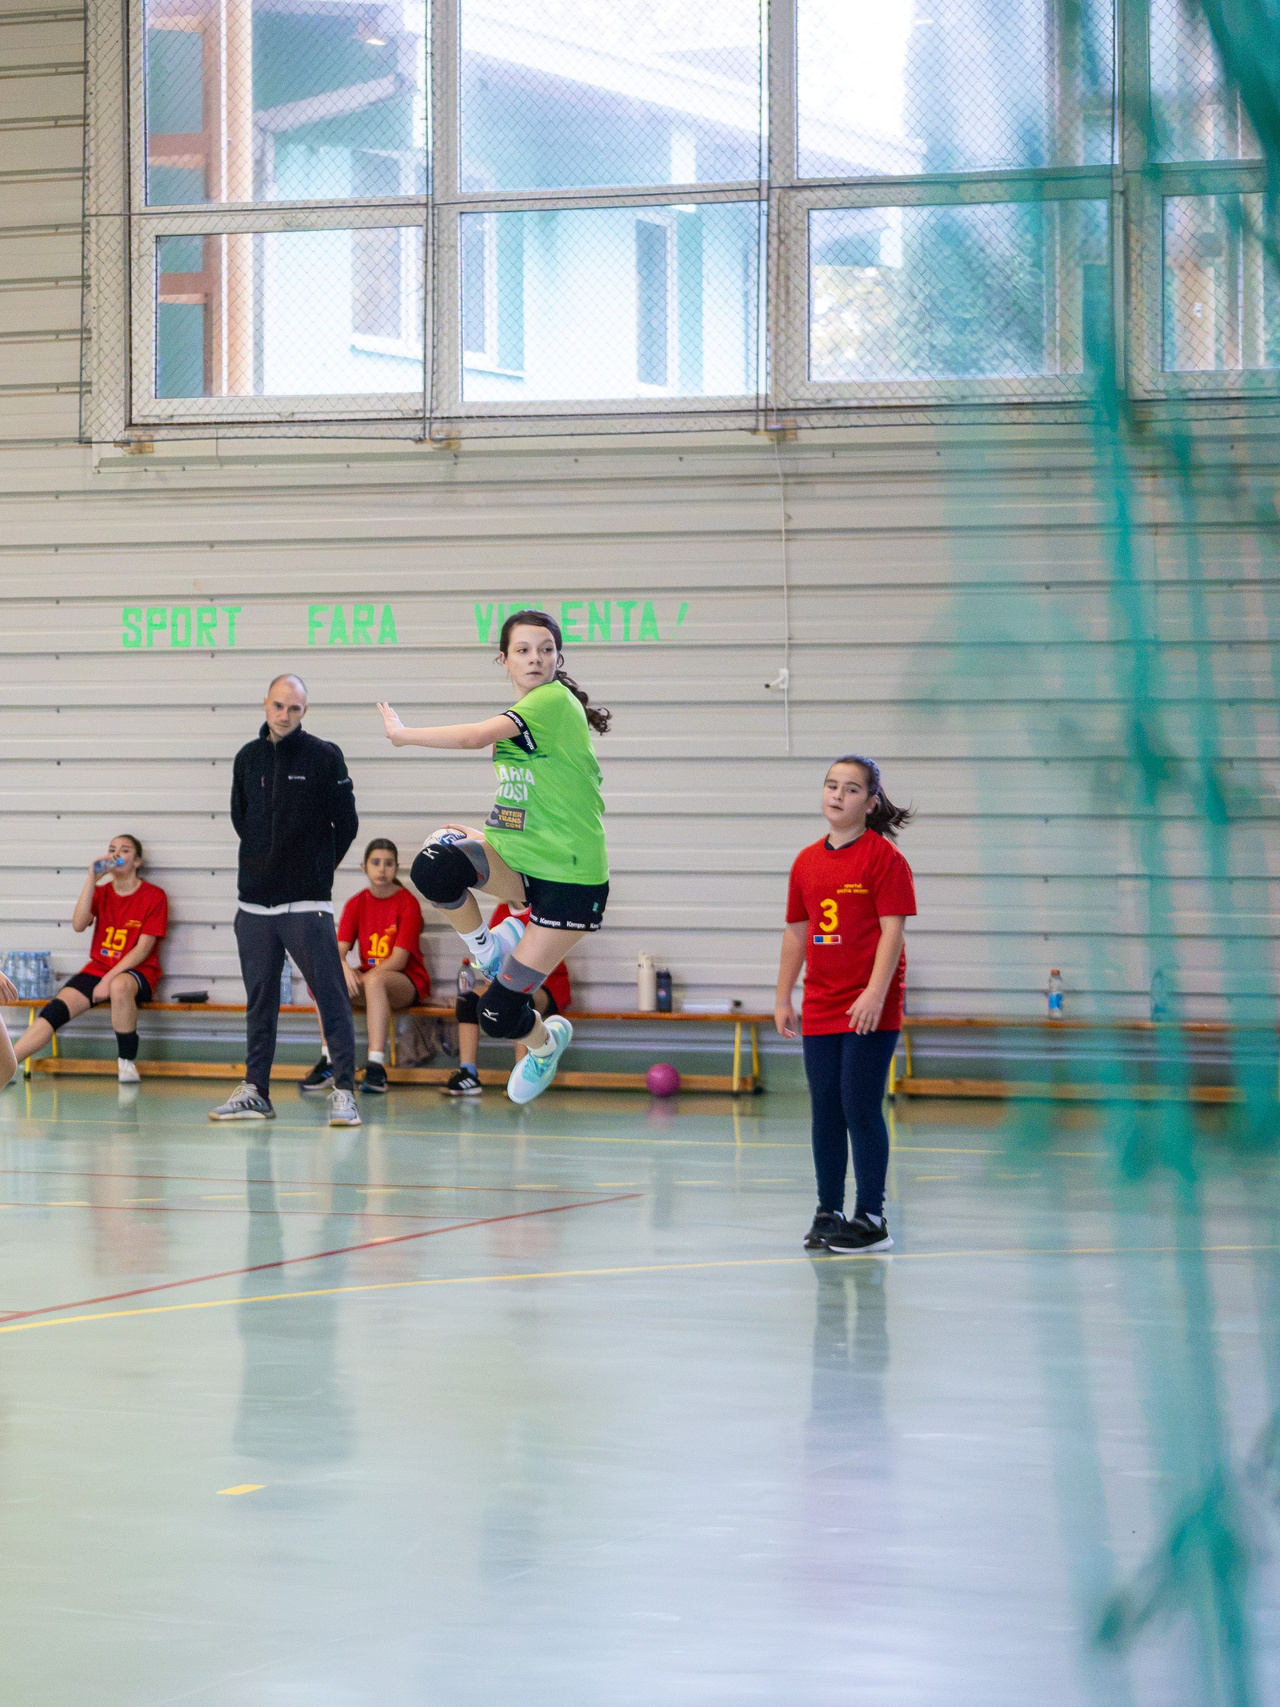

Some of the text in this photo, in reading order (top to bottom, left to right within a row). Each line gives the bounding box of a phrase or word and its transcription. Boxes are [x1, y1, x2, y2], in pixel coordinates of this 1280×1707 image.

[122, 606, 243, 648] SPORT
[308, 604, 399, 646] FARA
[540, 917, 560, 927] Kempa
[819, 898, 839, 933] 3
[101, 926, 128, 950] 15
[367, 932, 389, 958] 16
